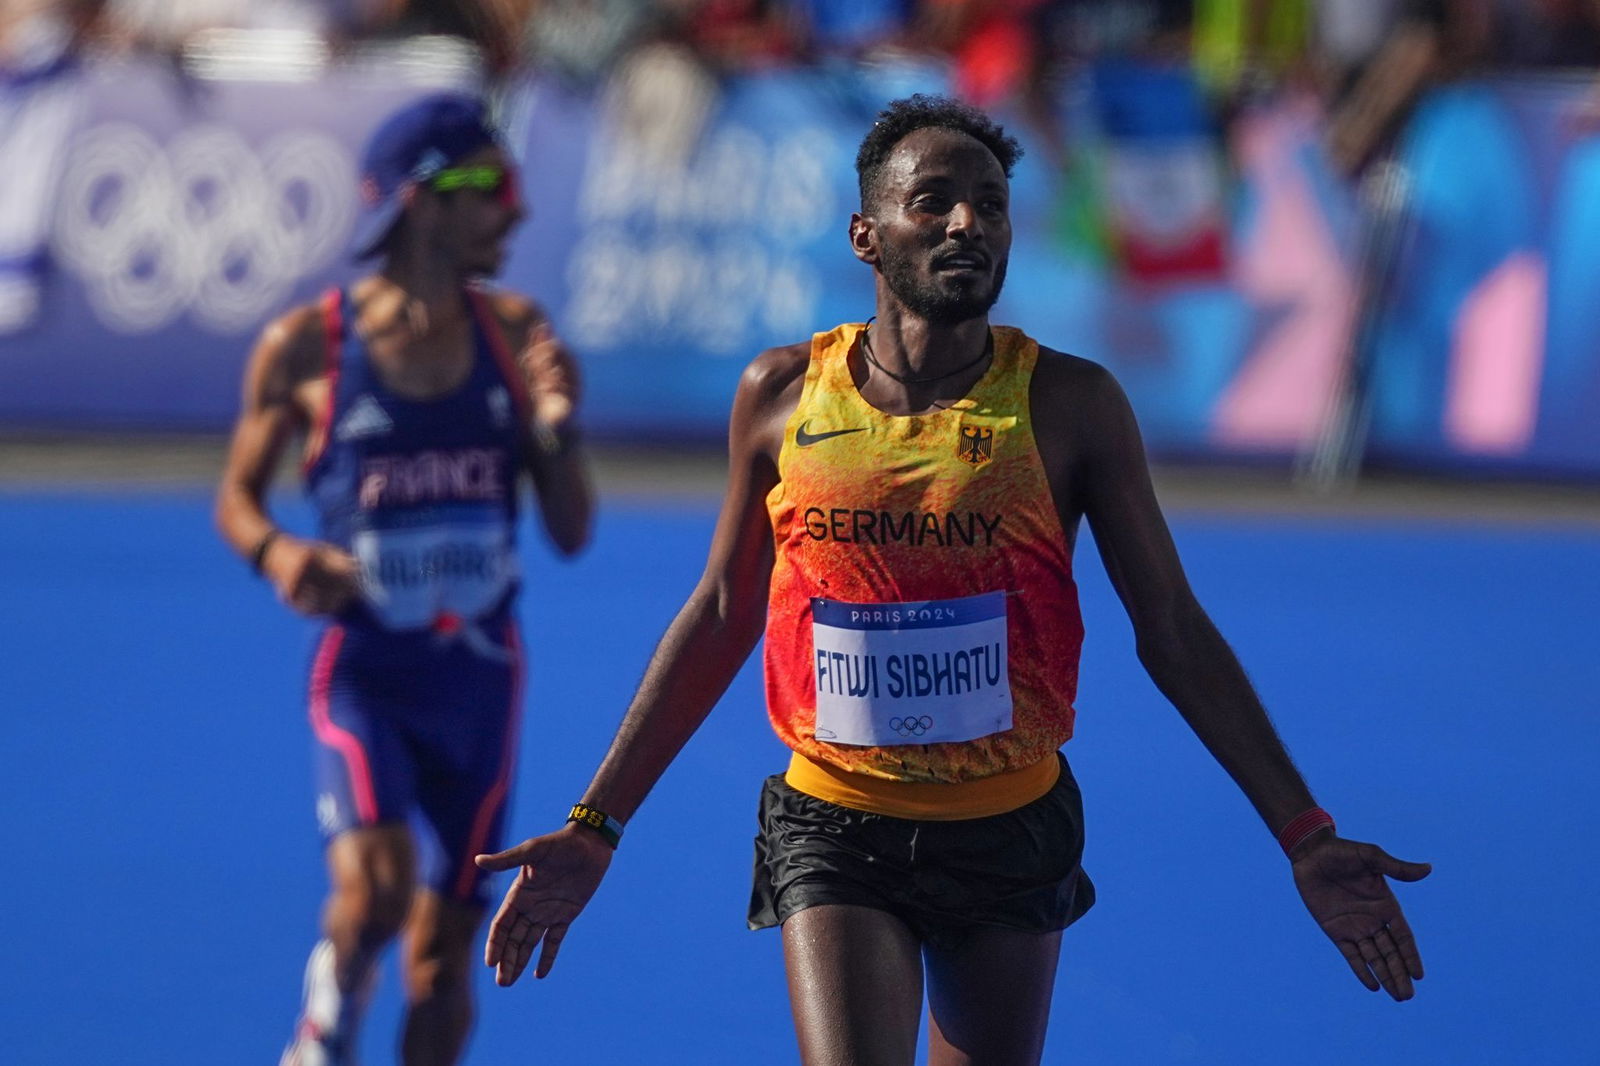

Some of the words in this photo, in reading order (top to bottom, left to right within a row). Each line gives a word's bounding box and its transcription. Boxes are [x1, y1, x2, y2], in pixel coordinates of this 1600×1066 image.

[804, 507, 1002, 546] GERMANY
[851, 610, 901, 623] PARIS
[907, 607, 956, 622] 2024
[816, 648, 880, 699] FITWI
[886, 642, 1001, 698] SIBHATU
